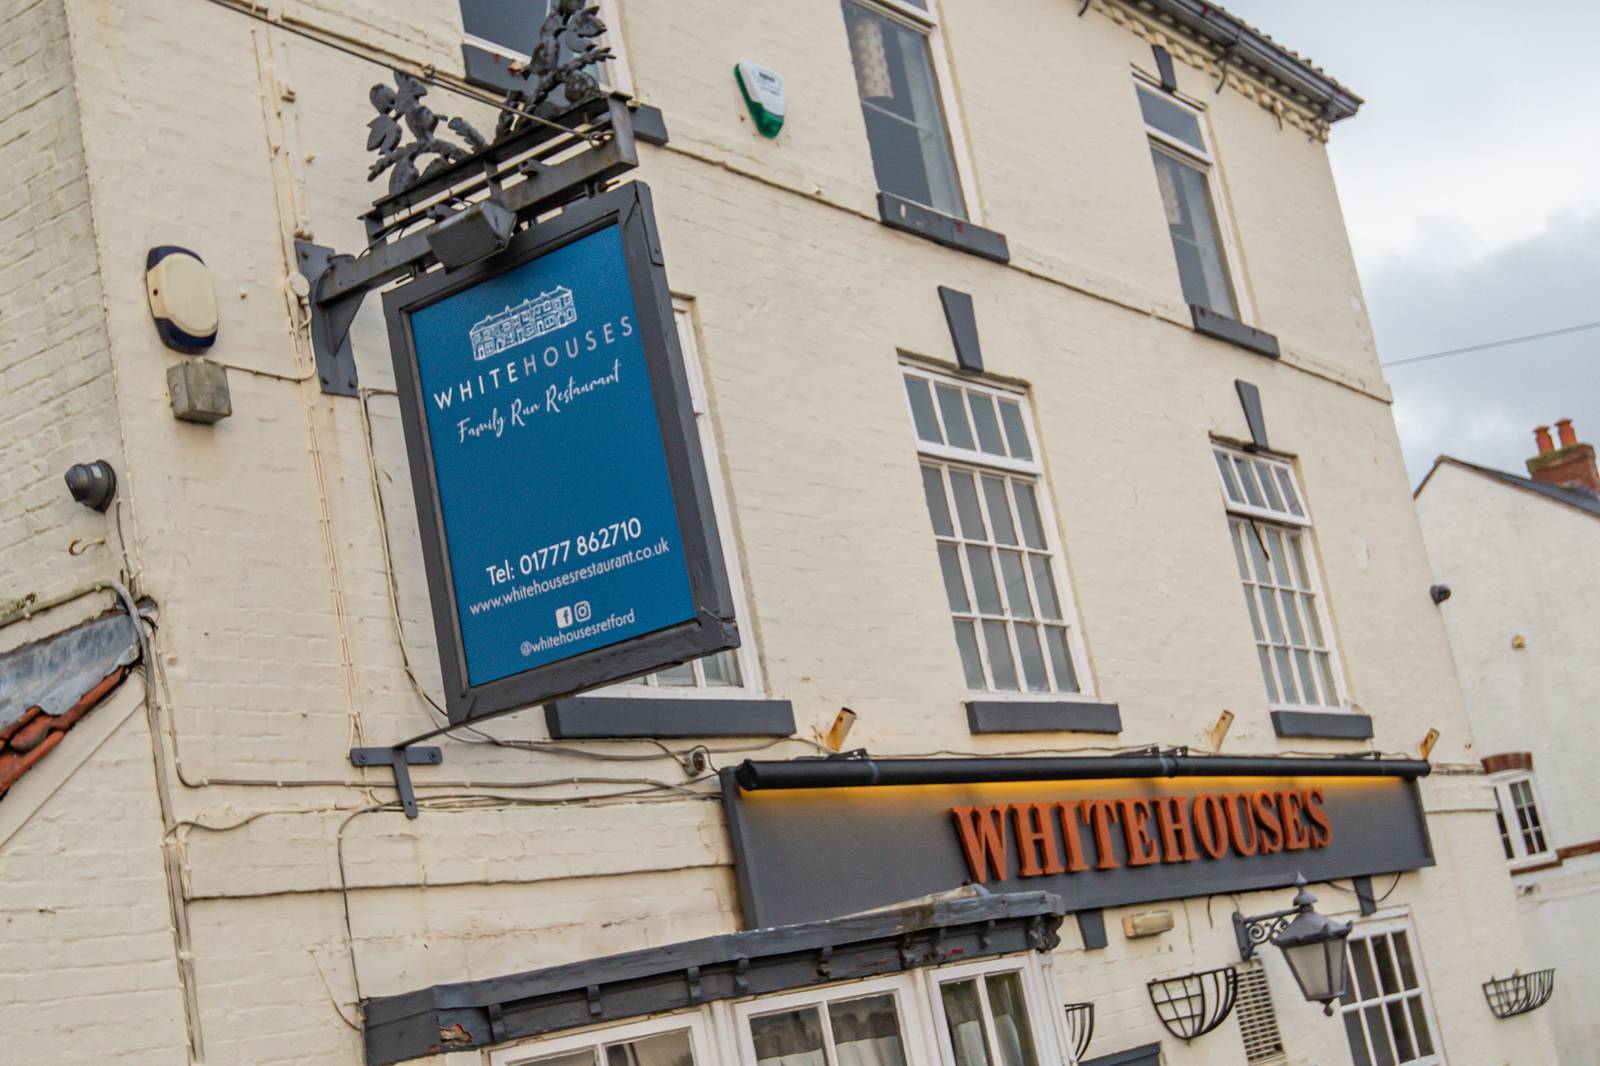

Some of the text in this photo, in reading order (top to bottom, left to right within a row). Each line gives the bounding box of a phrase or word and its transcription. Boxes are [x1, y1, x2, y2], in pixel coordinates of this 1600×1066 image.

[433, 315, 633, 410] WHITEHOUSES
[457, 358, 621, 443] Family Run Restaurant
[469, 537, 670, 616] www.whitehousesrestaurant.co.uk
[486, 517, 642, 586] Tel: 01777 862710
[520, 608, 636, 656] @whitehousesretford
[950, 787, 1333, 884] WHITEHOUSES
